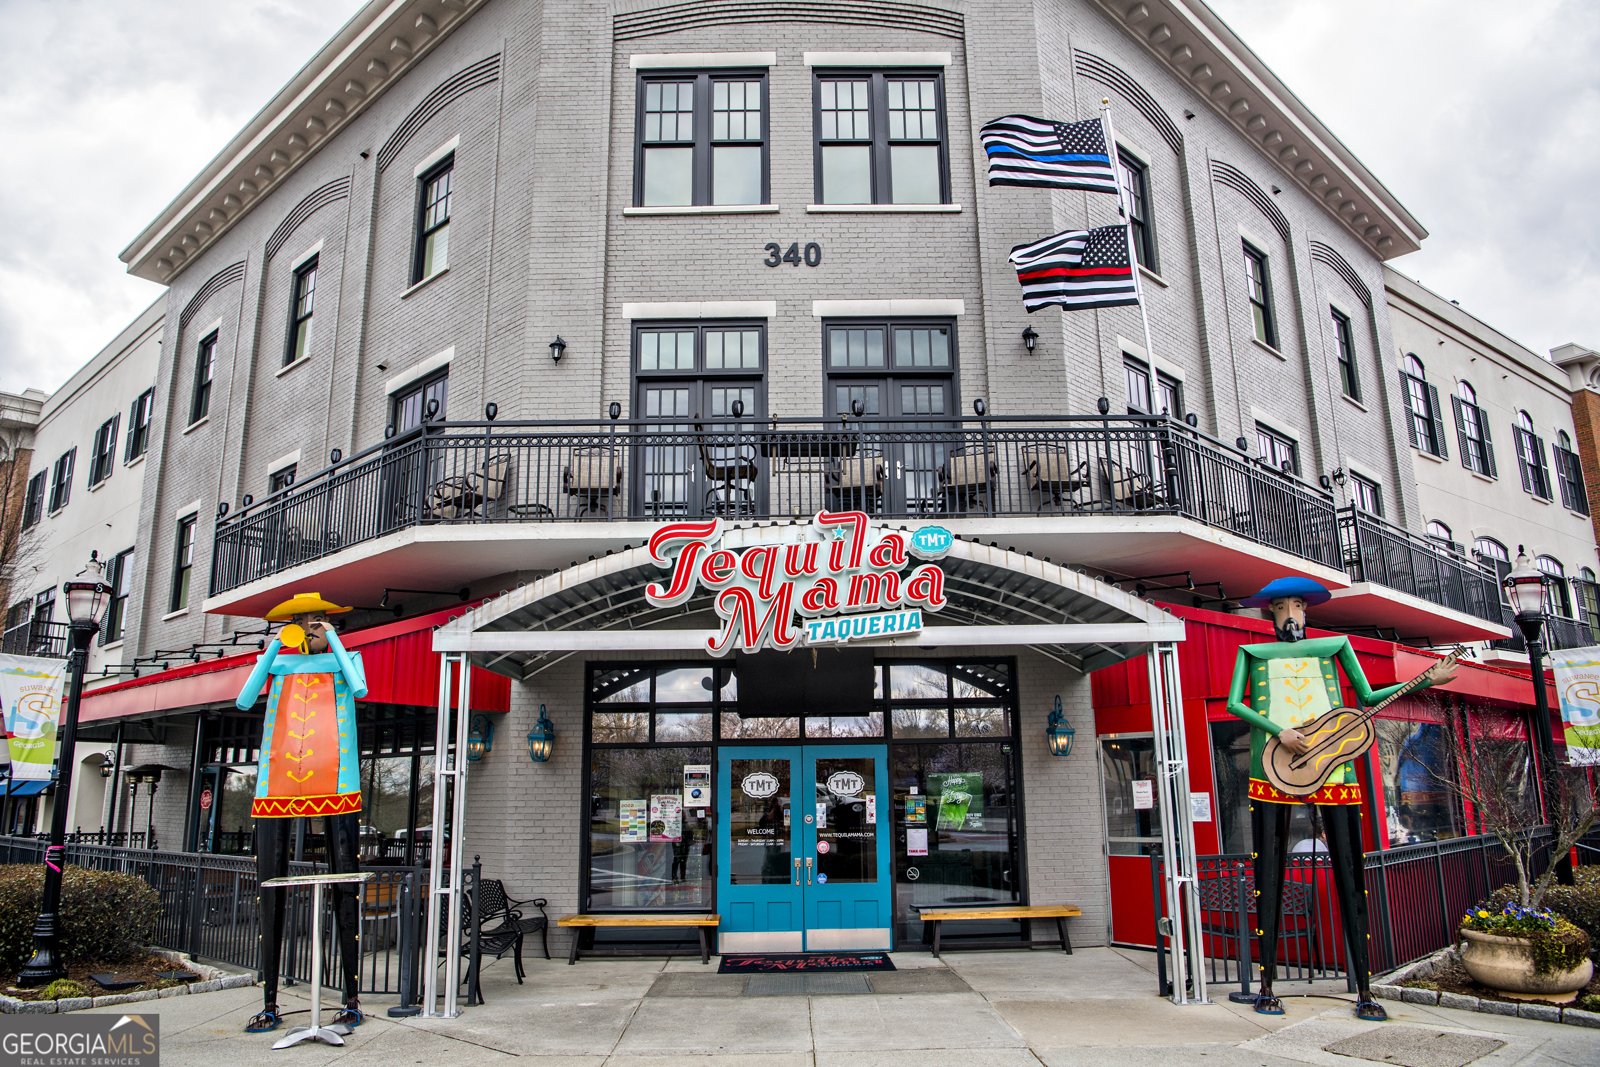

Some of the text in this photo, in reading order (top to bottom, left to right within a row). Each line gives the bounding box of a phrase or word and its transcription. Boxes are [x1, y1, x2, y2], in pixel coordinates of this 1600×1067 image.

[764, 242, 821, 267] 340
[918, 534, 947, 547] TMT
[646, 510, 908, 602] Tequila
[707, 565, 946, 651] Mama
[807, 611, 922, 641] TAQUERIA
[749, 779, 773, 792] TMT
[834, 778, 858, 790] TMT
